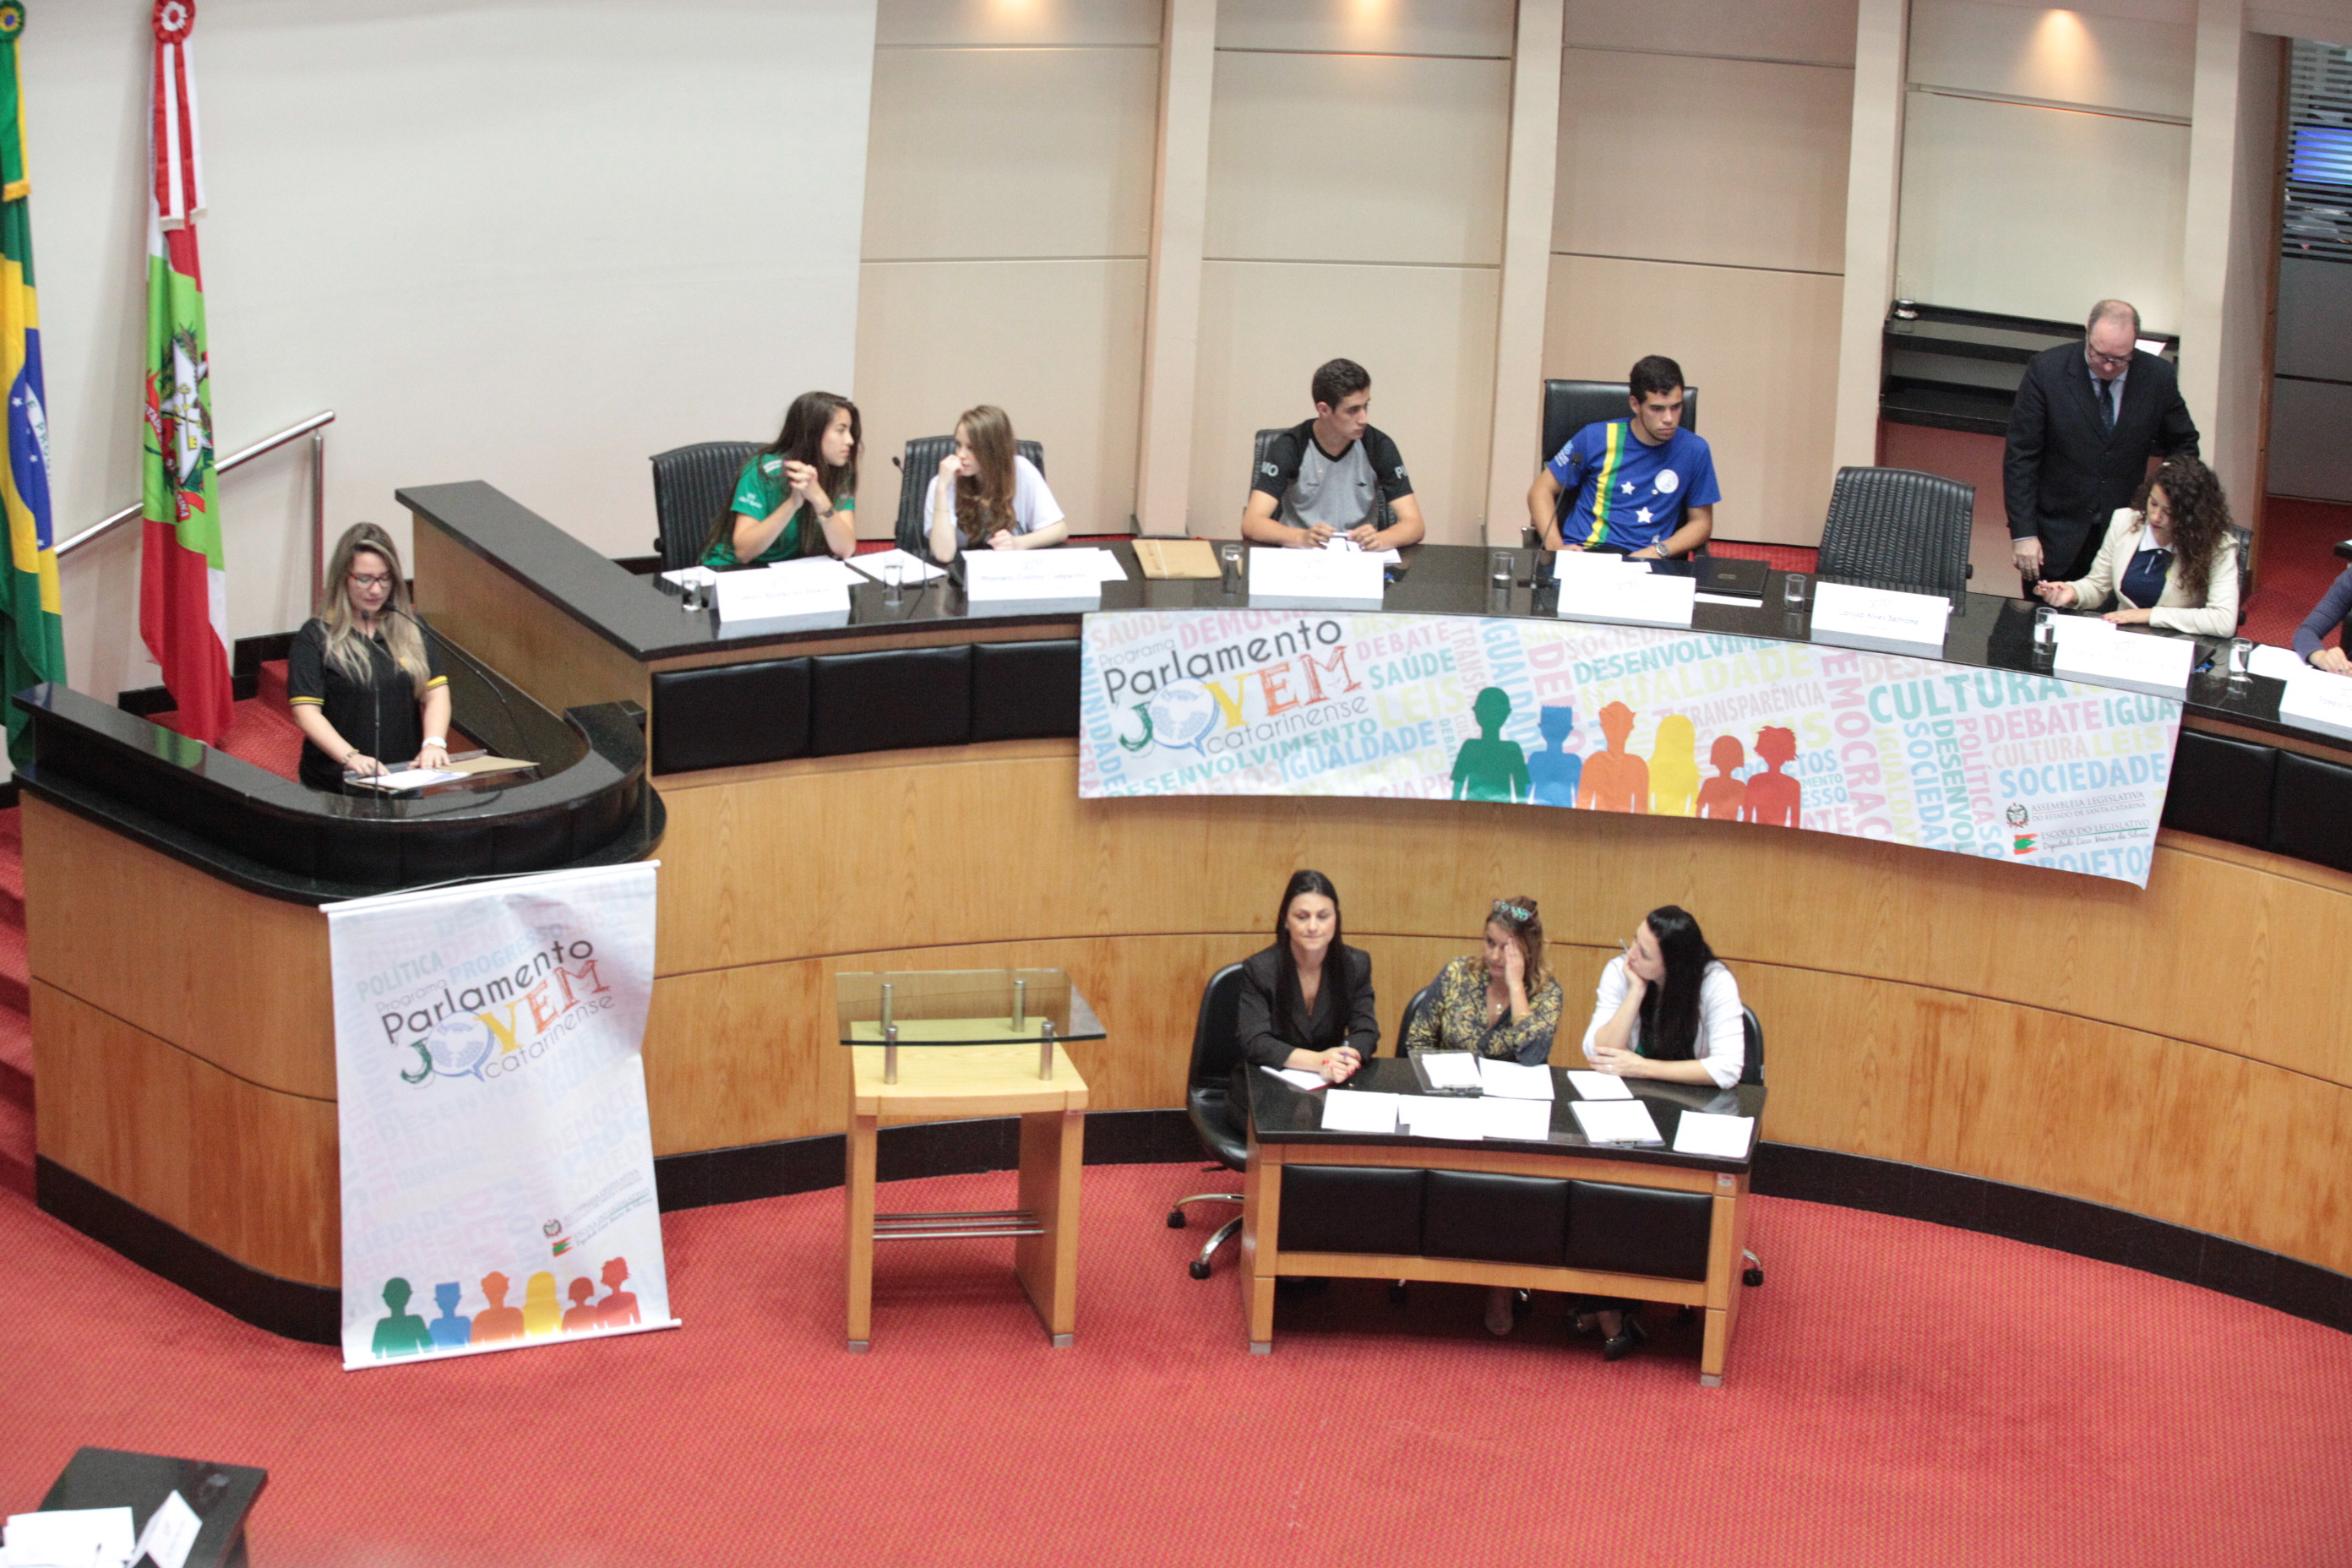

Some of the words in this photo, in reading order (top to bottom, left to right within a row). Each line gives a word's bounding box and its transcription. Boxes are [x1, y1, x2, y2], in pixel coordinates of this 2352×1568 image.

[1099, 639, 1175, 669] Programa
[1104, 619, 1342, 705] Parlamento
[1356, 621, 1451, 662] DEBATE
[1368, 646, 1456, 690] SAÚDE
[1375, 675, 1467, 729] LEIS
[1868, 672, 2067, 724] CULTURA
[1983, 700, 2103, 743] DEBATE
[1206, 694, 1369, 755] catarinense
[2092, 725, 2164, 757] LEIS
[1278, 721, 1438, 783] IGUALDADE
[1956, 717, 1996, 826] POLÍTICA
[1991, 734, 2090, 769] CULTURA
[1999, 753, 2166, 799] SOCIEDADE
[355, 950, 446, 1002] POLÍTICA
[375, 978, 448, 1013] Programa
[381, 939, 594, 1044] Parlamento
[484, 994, 616, 1080] catarinense
